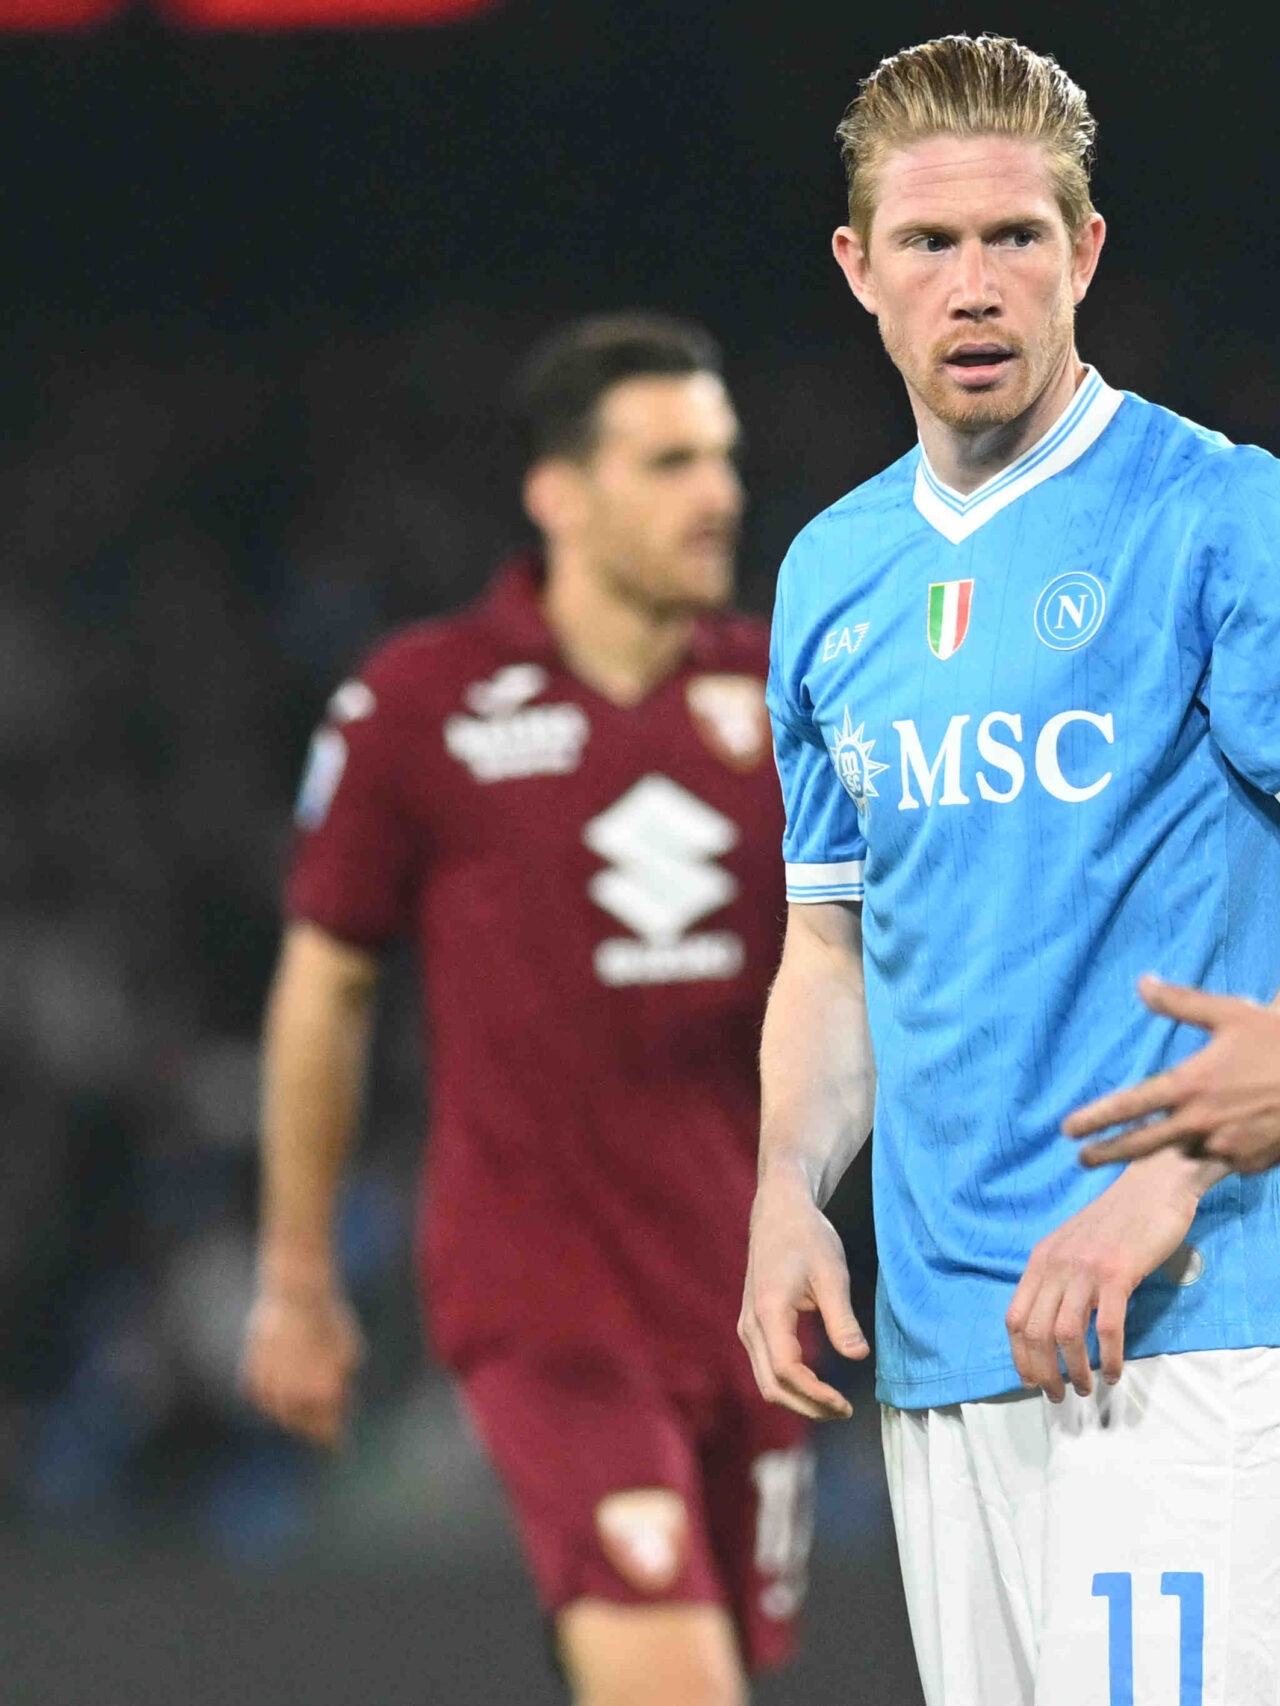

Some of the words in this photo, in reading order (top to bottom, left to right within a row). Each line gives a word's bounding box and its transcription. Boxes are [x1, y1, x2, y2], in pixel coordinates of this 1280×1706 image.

[822, 621, 871, 662] EA7
[1053, 594, 1089, 629] N
[892, 710, 1114, 811] MSC
[1091, 1571, 1204, 1706] 11
